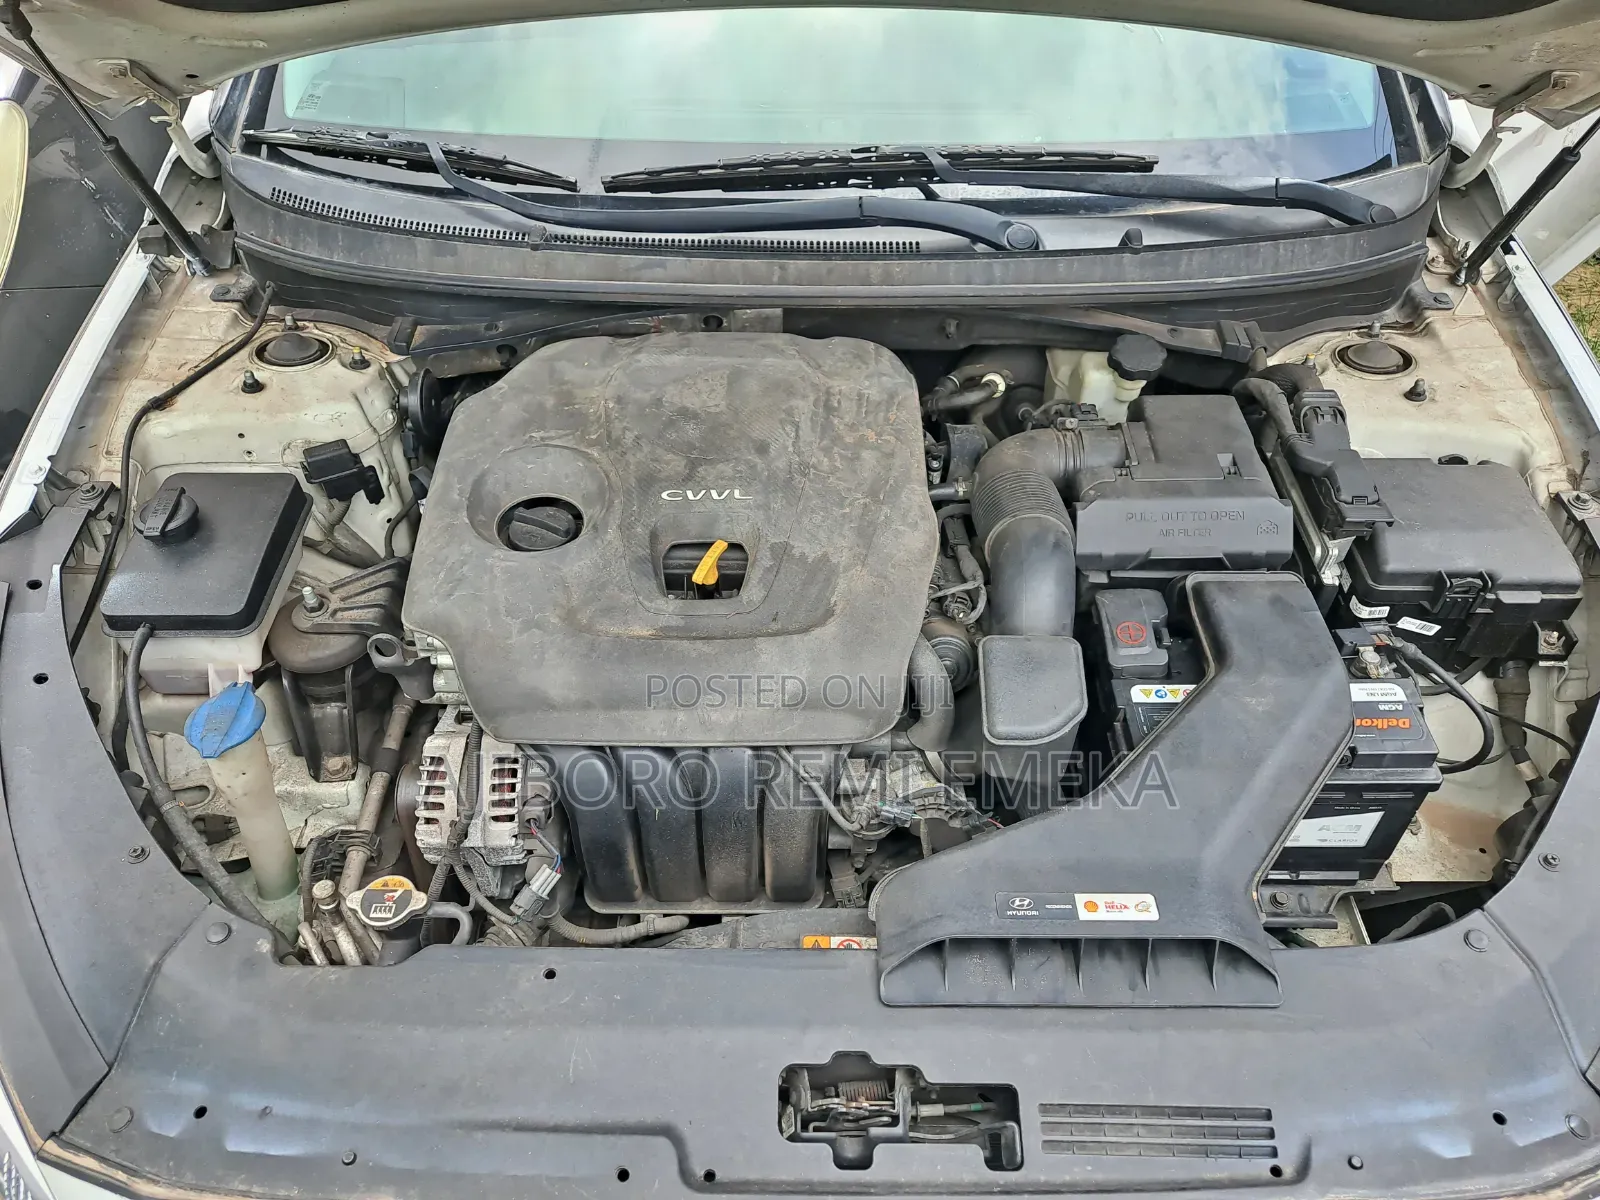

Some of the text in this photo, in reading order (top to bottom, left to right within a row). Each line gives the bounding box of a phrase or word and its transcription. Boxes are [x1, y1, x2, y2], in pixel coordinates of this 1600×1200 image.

[660, 488, 753, 500] CVVL
[1125, 510, 1245, 523] PULL OUT TO OPEN
[1159, 528, 1212, 538] AIR FILTER
